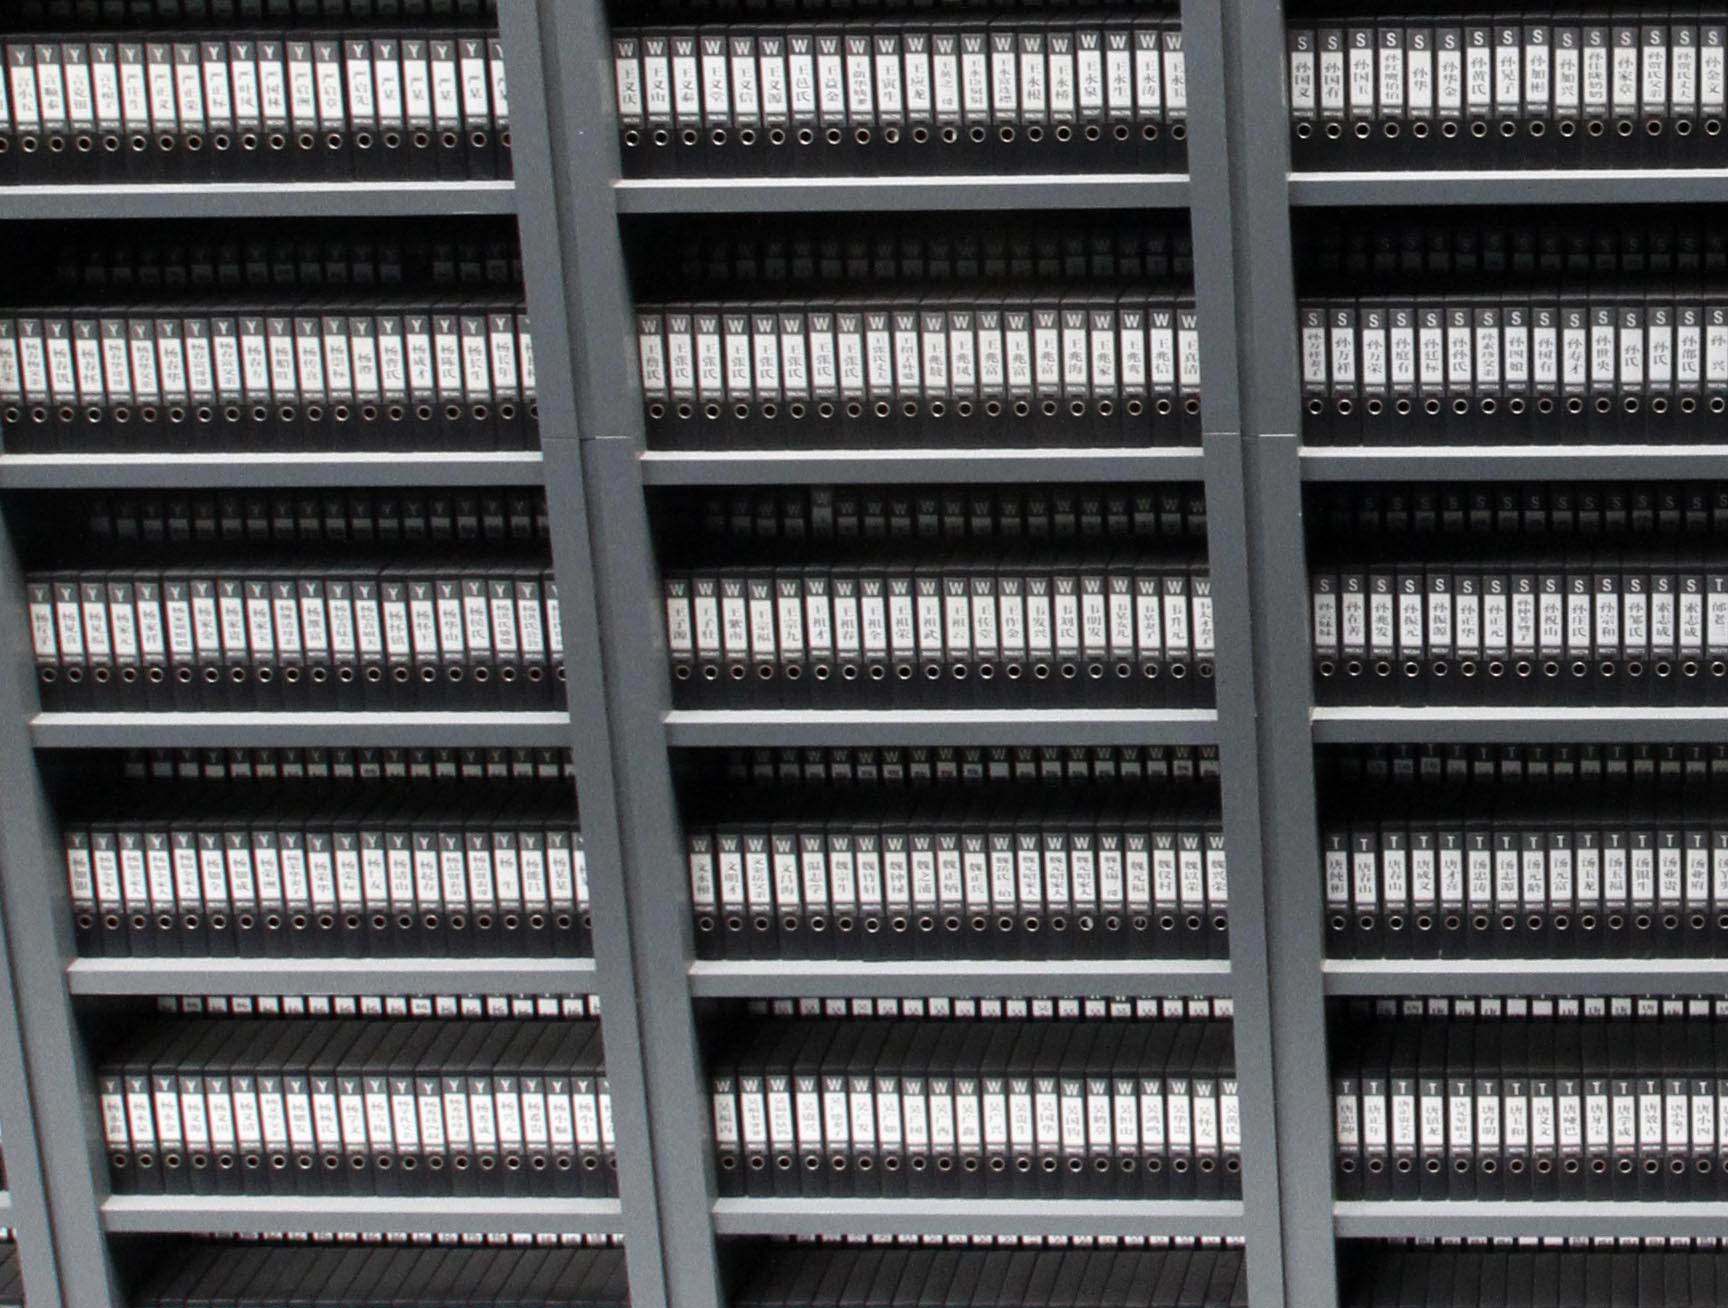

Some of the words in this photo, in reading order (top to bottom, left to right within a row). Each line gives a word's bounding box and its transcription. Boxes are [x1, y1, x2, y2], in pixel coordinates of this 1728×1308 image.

[1110, 35, 1126, 49] W
[1298, 36, 1307, 50] S
[1328, 36, 1338, 50] S
[1415, 35, 1424, 49] S
[1445, 35, 1455, 49] S
[1474, 31, 1484, 45] S
[1563, 33, 1572, 47] S
[1708, 31, 1718, 45] S
[125, 49, 135, 62] Y
[437, 46, 447, 59] Y
[1338, 312, 1347, 326] S
[1454, 312, 1464, 326] S
[1626, 313, 1636, 327] S
[1656, 311, 1666, 325] S
[1684, 311, 1694, 325] S
[383, 321, 393, 334] Y
[728, 320, 744, 333] W
[1625, 345, 1640, 367] 孙氏
[1654, 342, 1668, 365] 孙氏
[333, 585, 342, 598] Y
[949, 582, 963, 595] W
[1463, 580, 1472, 593] S
[1491, 580, 1501, 593] S
[393, 836, 403, 848] Y
[776, 840, 791, 853] W
[966, 839, 981, 852] W
[1420, 836, 1428, 848] T
[424, 1083, 433, 1095] Y
[959, 1082, 974, 1095] W
[1620, 1082, 1627, 1095] T
